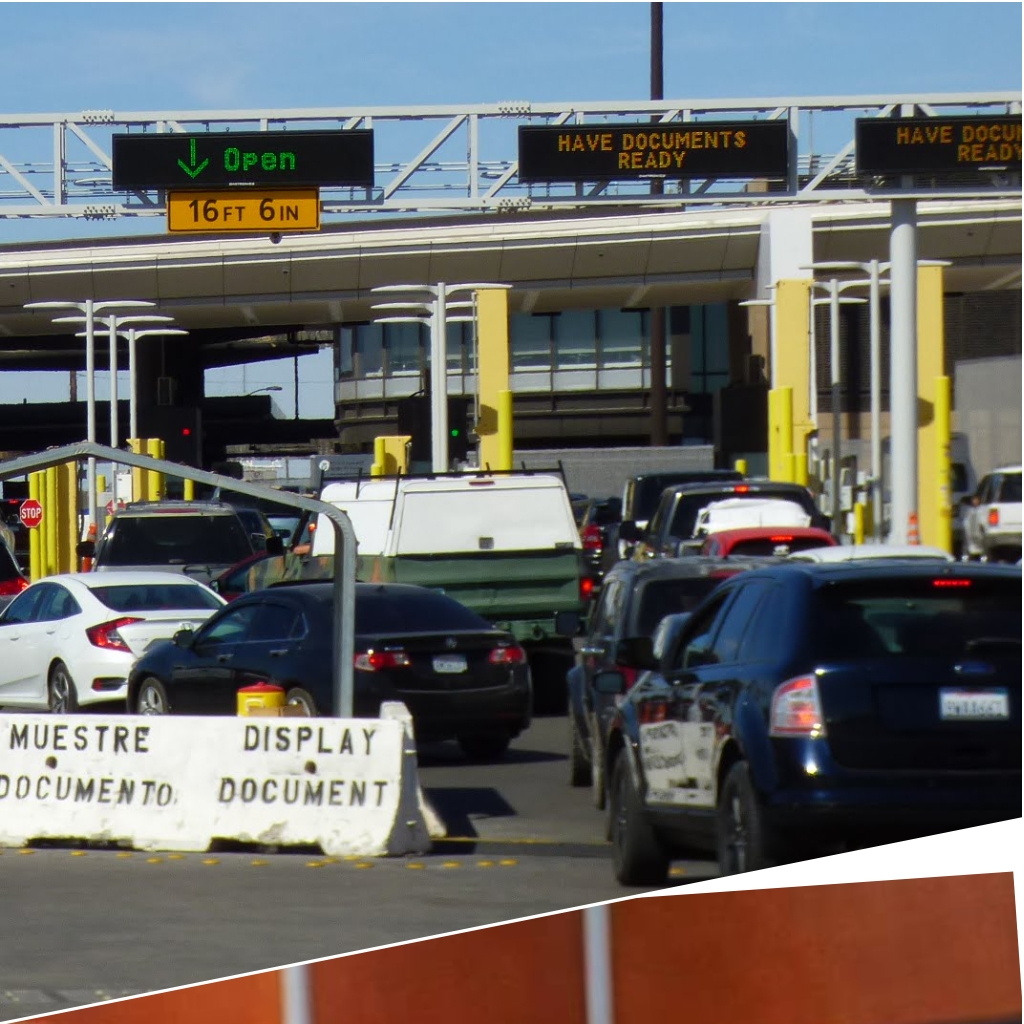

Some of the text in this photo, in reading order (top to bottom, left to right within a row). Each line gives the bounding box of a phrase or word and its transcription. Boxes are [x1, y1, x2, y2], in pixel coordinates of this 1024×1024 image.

[558, 130, 747, 152] HAVE DOCUMENTS
[896, 125, 954, 145] HAVE
[224, 147, 296, 172] Open
[618, 151, 686, 169] READY
[21, 507, 42, 519] STOP
[9, 723, 151, 754] MUESTRE
[243, 725, 376, 755] DISPLAY
[218, 776, 388, 807] DOCUMENT
